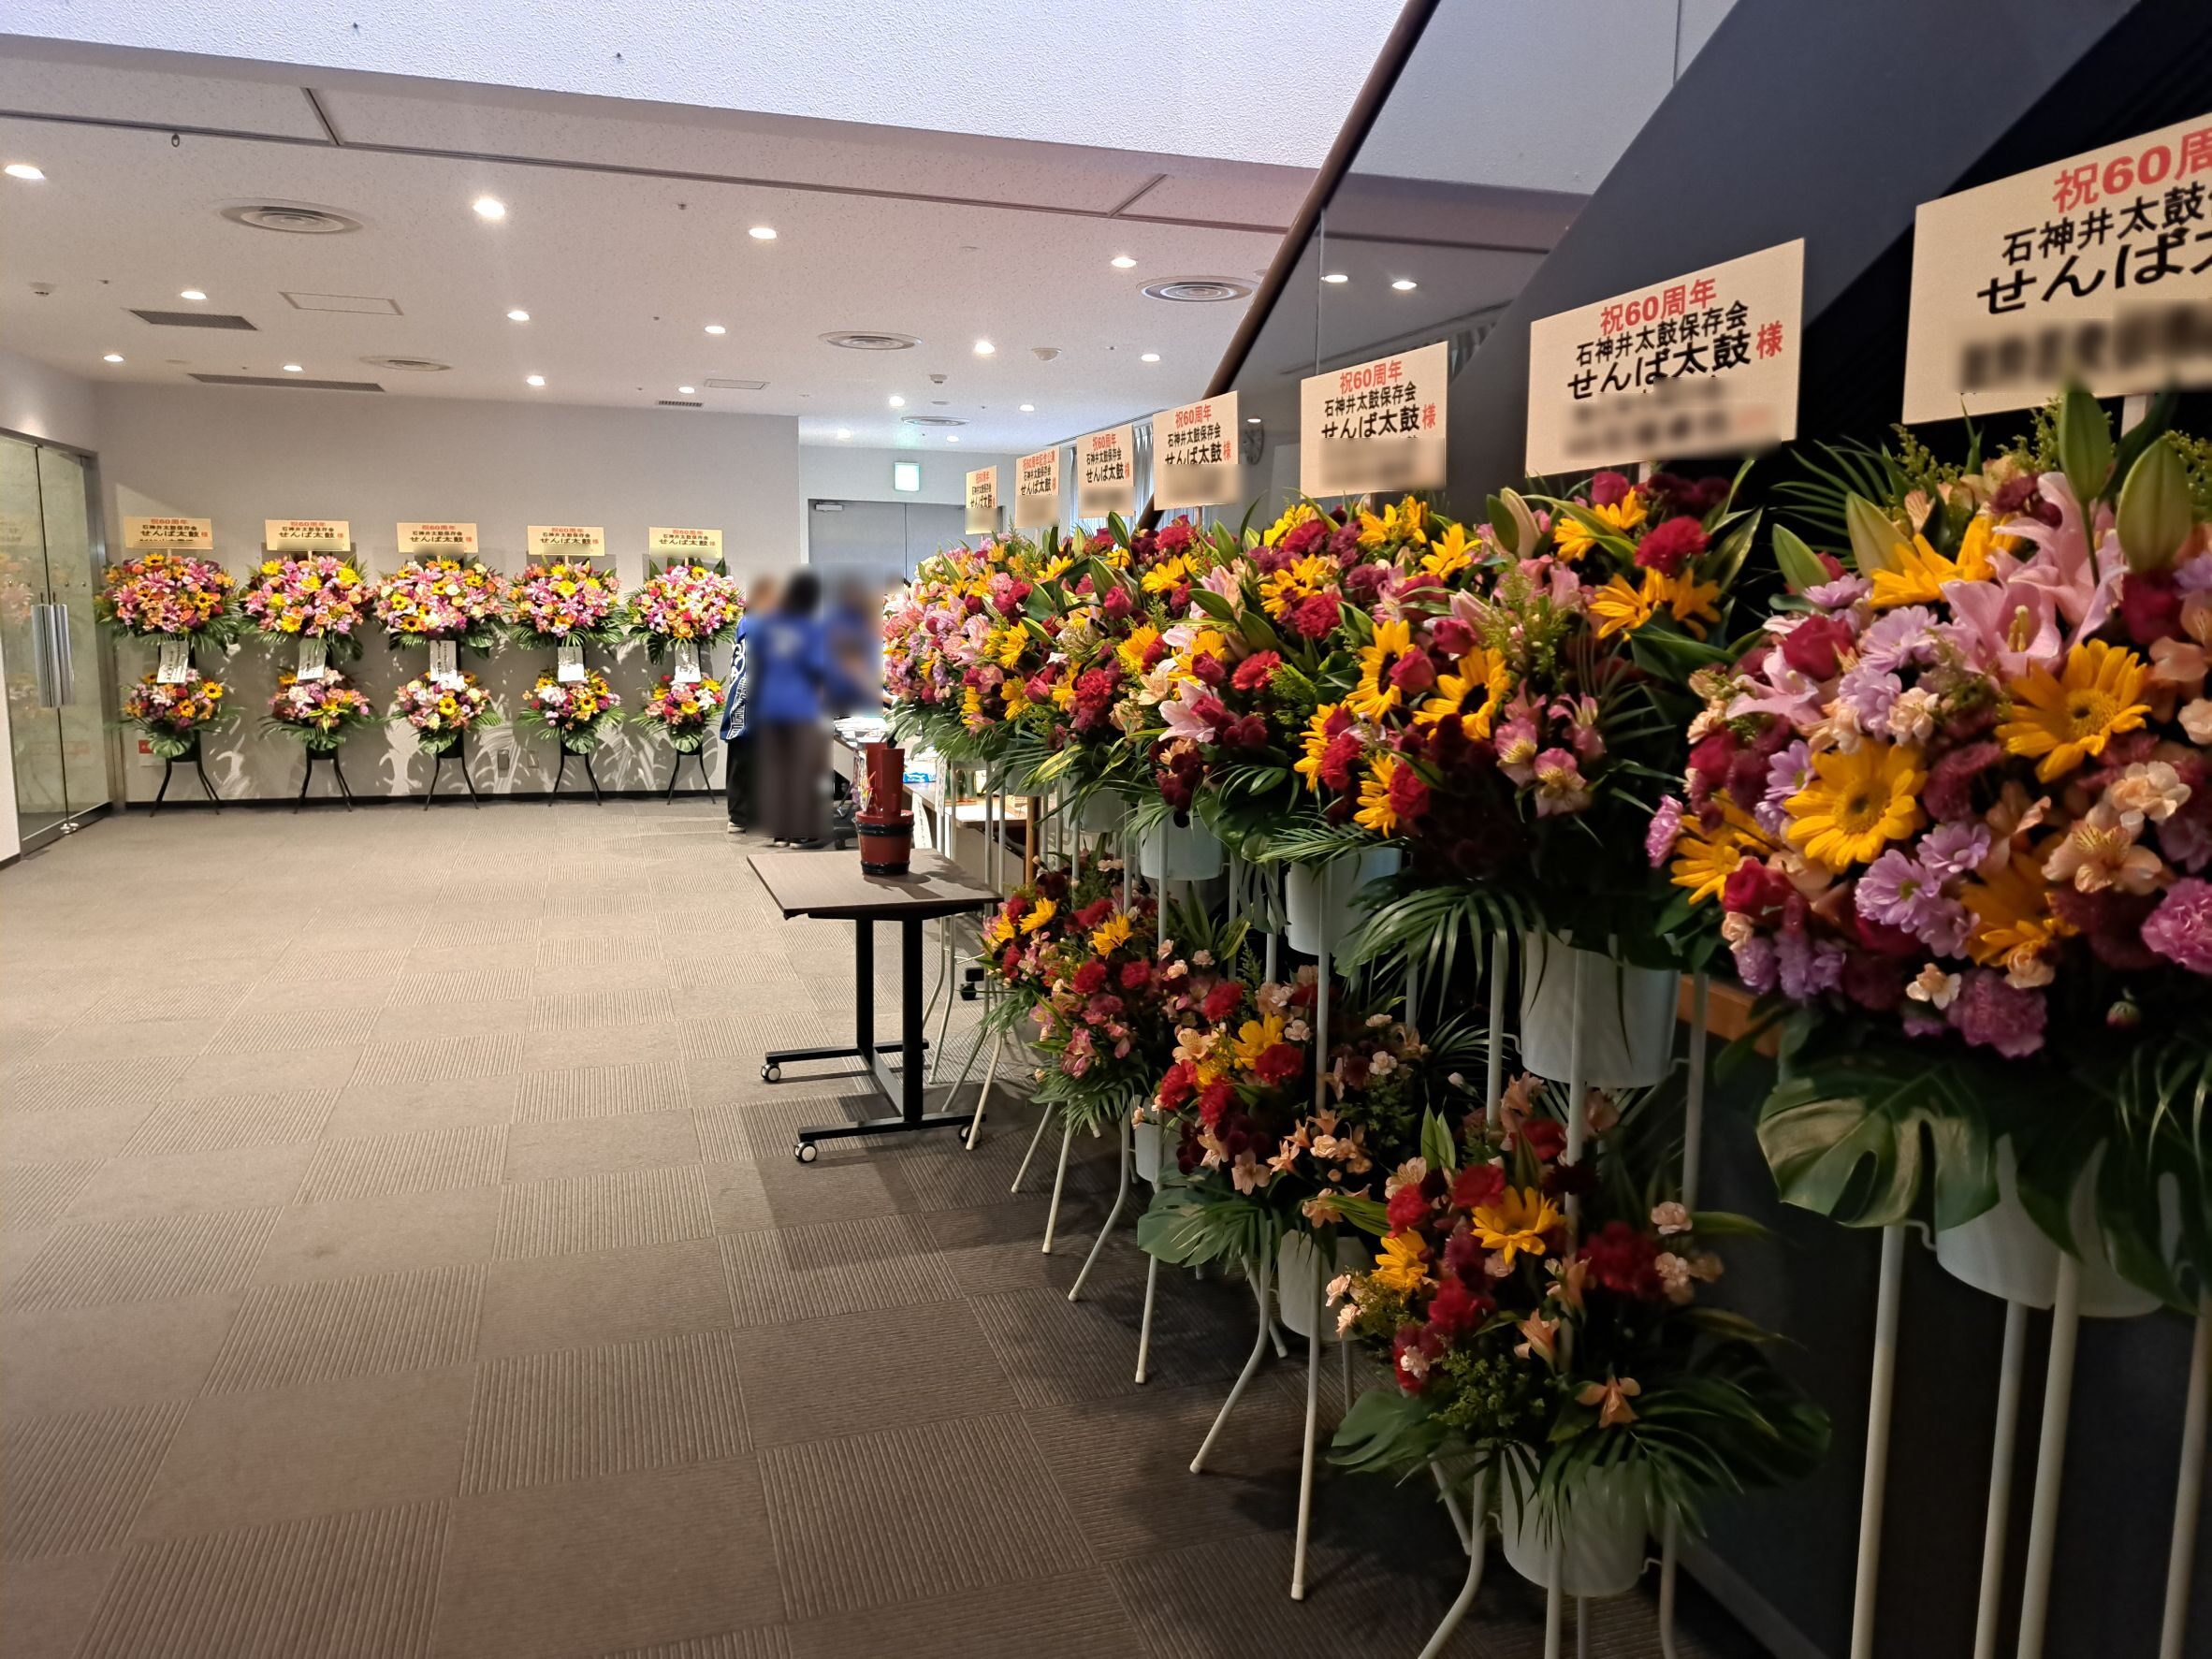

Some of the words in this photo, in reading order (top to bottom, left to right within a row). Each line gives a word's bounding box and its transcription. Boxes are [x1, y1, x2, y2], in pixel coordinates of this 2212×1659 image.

[2001, 181, 2212, 267] 石神井太鼓
[1600, 278, 1717, 337] 祝60周年
[1576, 299, 1749, 368] 石神井太鼓保存会
[1339, 359, 1403, 395] 祝60周年
[1174, 403, 1212, 429] 祝60周年
[1324, 381, 1417, 418] 石神井太鼓保存会
[1167, 422, 1221, 448] 石神井太鼓保存会
